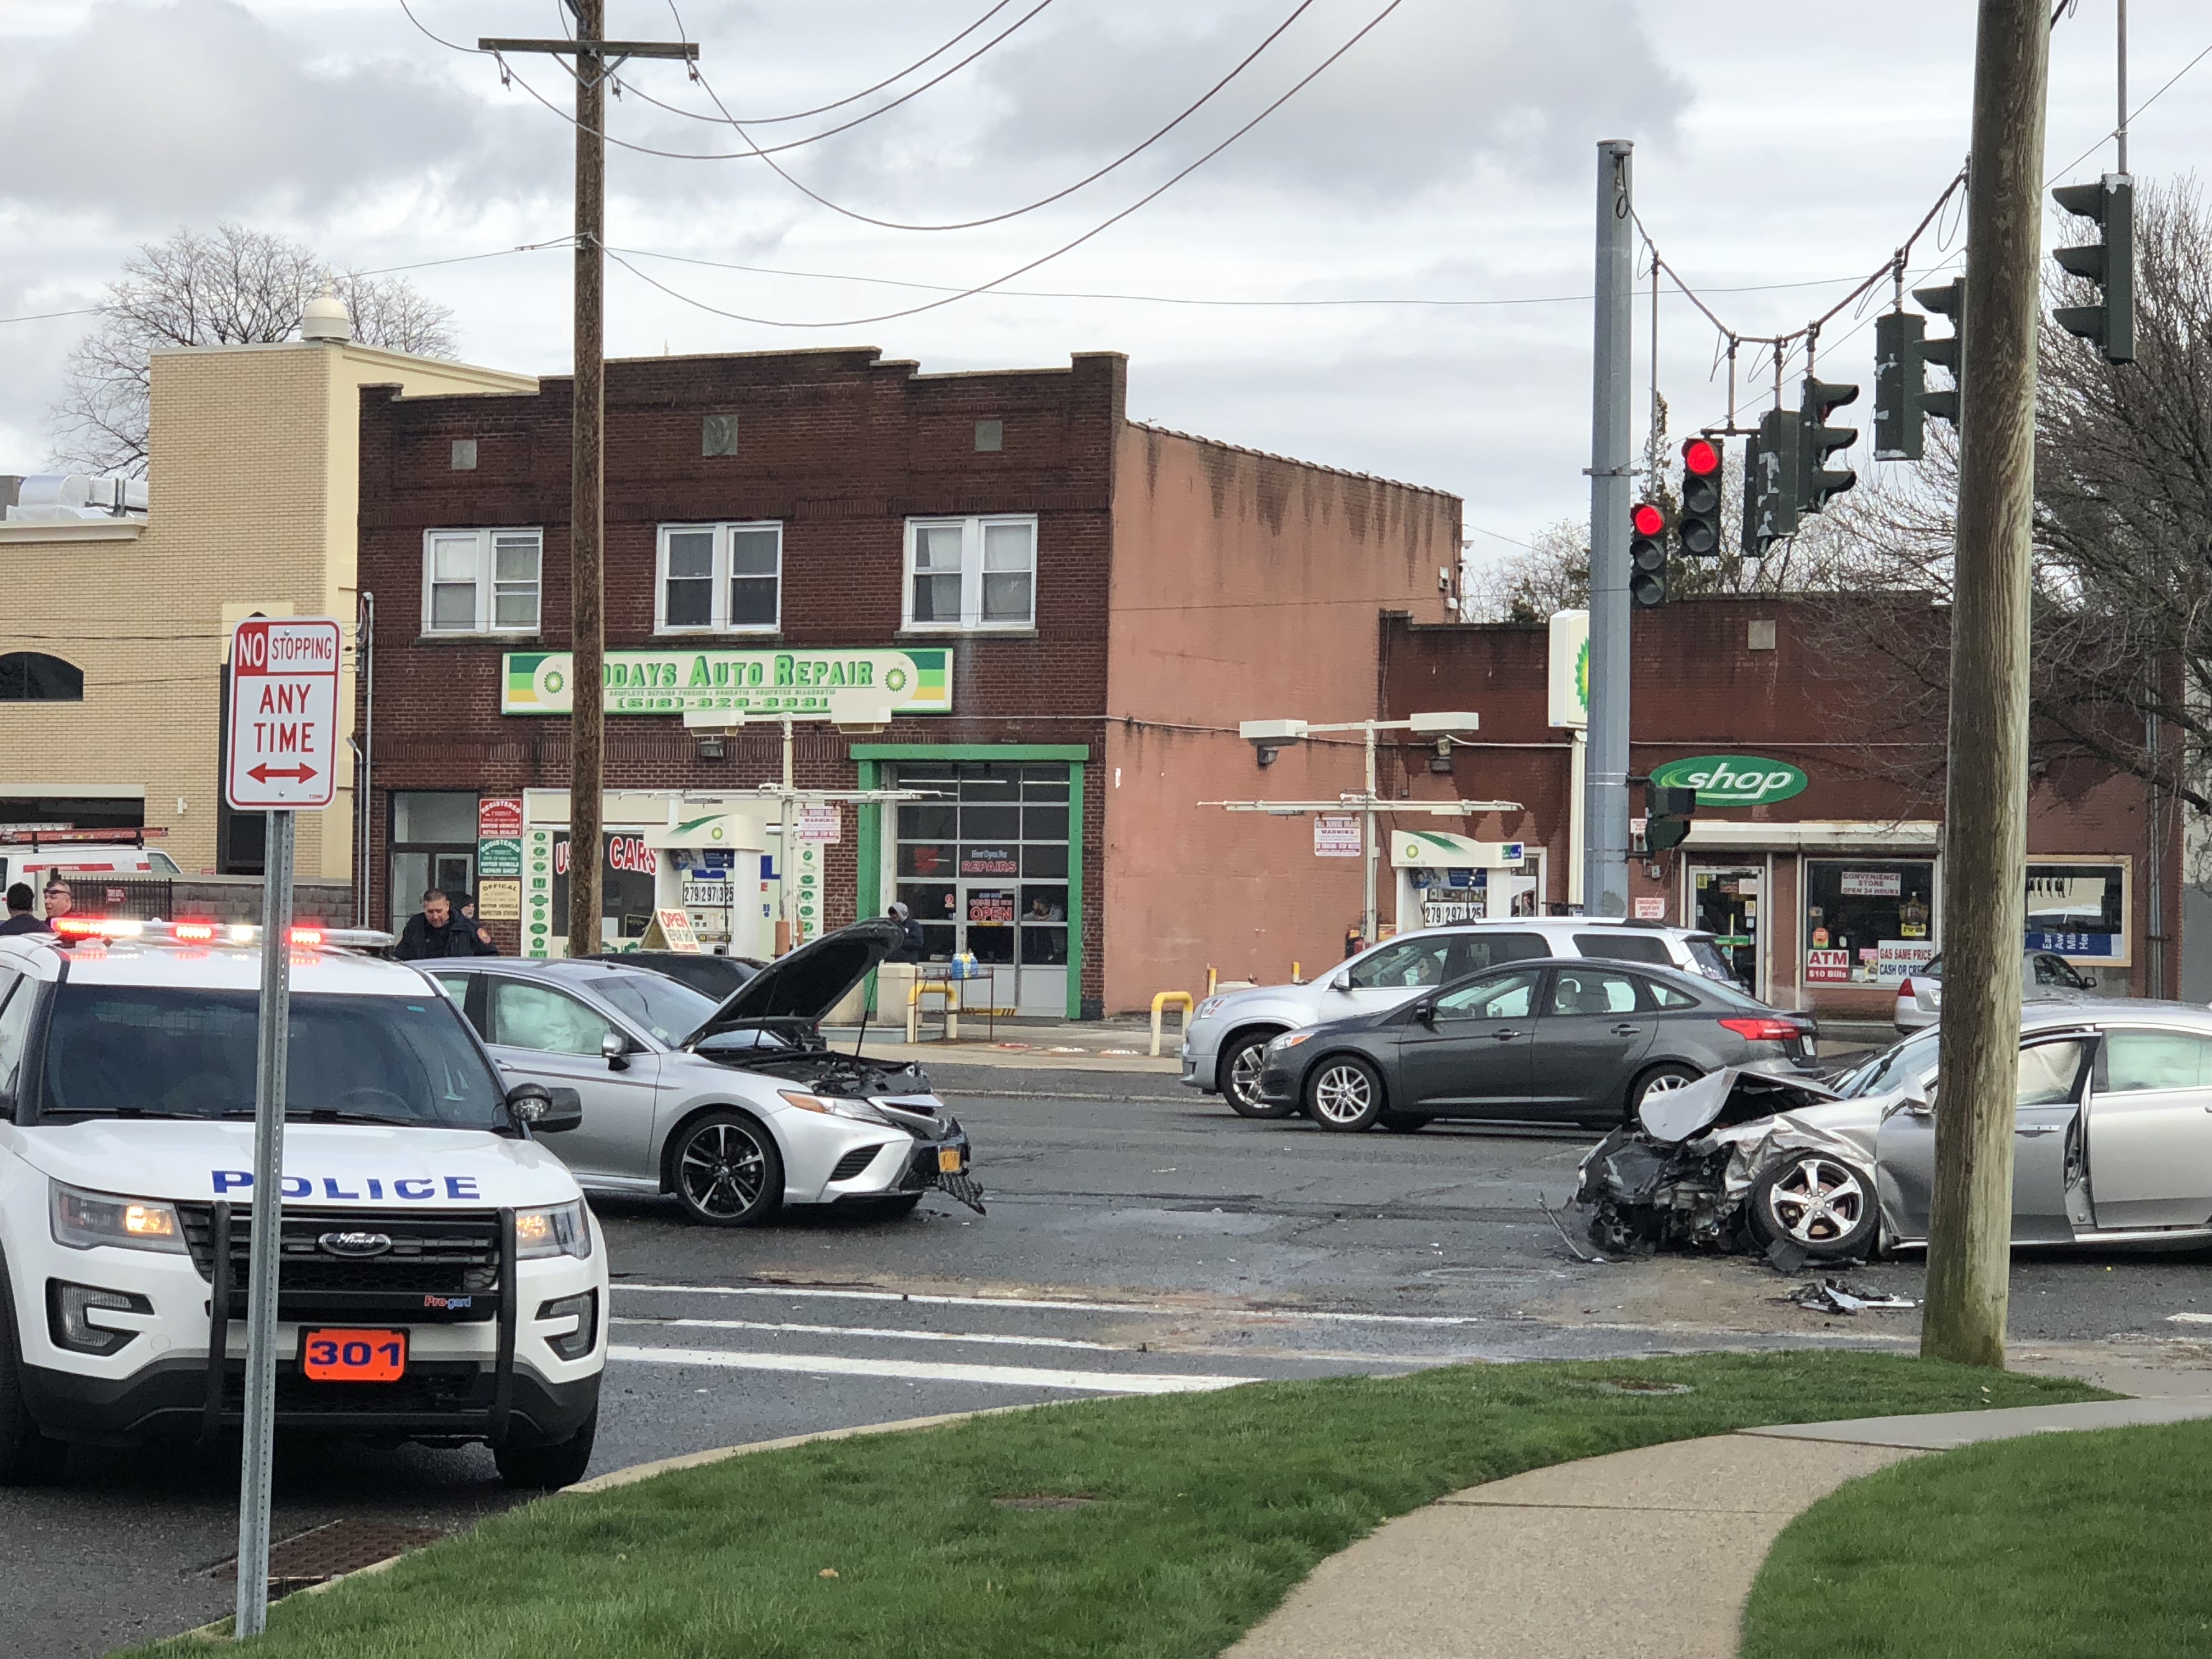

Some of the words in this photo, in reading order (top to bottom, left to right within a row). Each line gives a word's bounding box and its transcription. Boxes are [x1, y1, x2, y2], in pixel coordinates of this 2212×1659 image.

[239, 632, 266, 667] NO
[272, 637, 332, 660] STOPPING
[689, 654, 763, 687] AUTO
[774, 654, 874, 686] REPAIR
[259, 684, 311, 714] ANY
[253, 723, 314, 753] TIME
[1688, 763, 1795, 799] shop
[610, 836, 656, 875] CARS
[962, 860, 1017, 873] REPAIRS
[661, 911, 690, 930] OPEN
[970, 906, 1012, 921] OPEN
[1809, 952, 1847, 965] ATM
[1880, 948, 1893, 960] GAS
[1894, 949, 1912, 960] SAME
[1914, 949, 1932, 961] PRICE
[1827, 970, 1847, 978] Bills
[1880, 964, 1897, 975] CASH
[1898, 964, 1907, 976] OR
[211, 1170, 481, 1200] POLICE
[337, 1232, 376, 1246] Ford
[309, 1341, 400, 1367] 301
